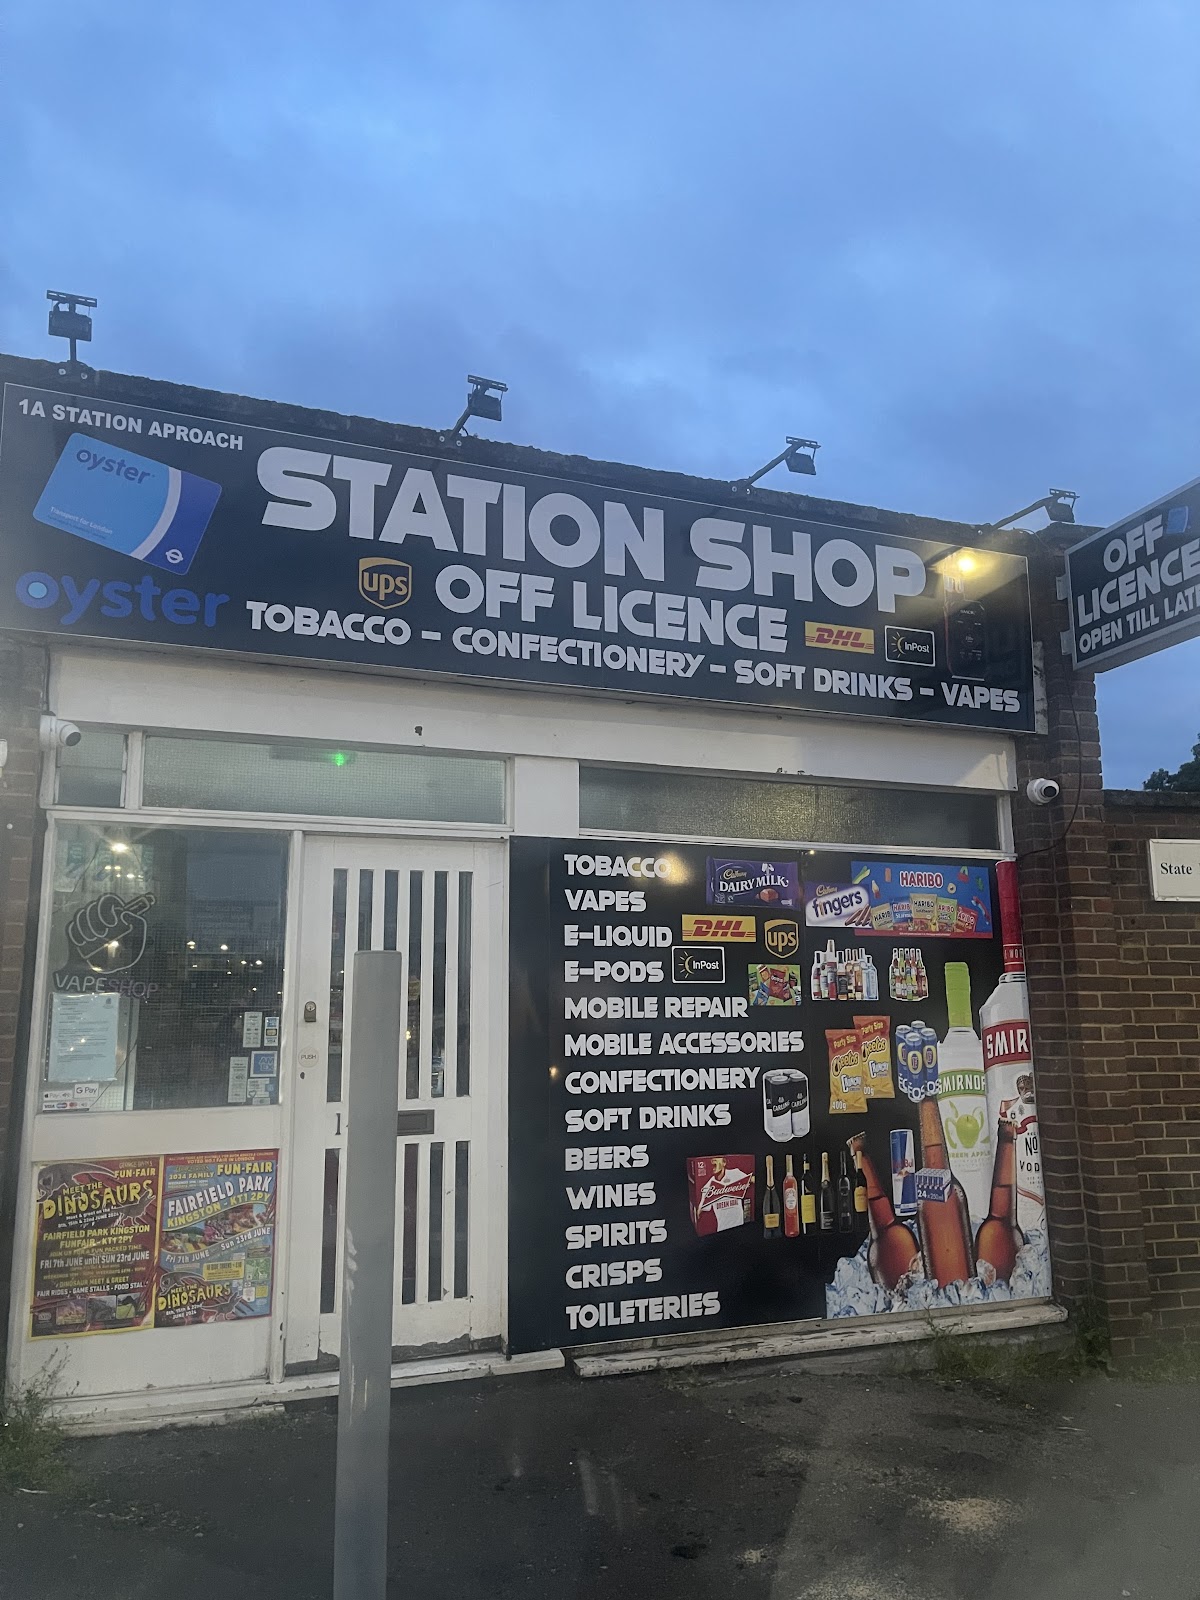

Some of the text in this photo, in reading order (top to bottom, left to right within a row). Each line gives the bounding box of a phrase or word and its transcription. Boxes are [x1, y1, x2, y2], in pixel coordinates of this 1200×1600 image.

[19, 399, 243, 450] 1A STATION APROACH
[76, 449, 150, 484] oyster
[50, 507, 79, 522] Transport
[90, 522, 112, 534] London
[256, 446, 926, 614] STATION SHOP
[1103, 514, 1164, 573] OFF
[363, 570, 408, 604] ups
[1077, 538, 1200, 628] LICENCE
[16, 571, 229, 626] oyster
[435, 565, 788, 653] OFF LICENCE
[815, 627, 865, 648] DHL
[1079, 618, 1123, 654] OPEN
[1126, 604, 1160, 635] TILL
[246, 600, 412, 645] TOBACCO
[452, 626, 705, 678] CONFECTIONERY
[734, 660, 805, 690] SOFT
[814, 668, 913, 701] DRINKS
[941, 682, 1021, 713] VAPES
[904, 641, 930, 654] InPost
[564, 853, 671, 878] TOBACCO
[1160, 862, 1192, 875] State
[719, 875, 789, 893] DAIRY MILK
[900, 871, 943, 888] HARIBO
[564, 889, 647, 912] VAPES
[812, 890, 863, 918] fingers
[914, 900, 934, 908] HARIBO
[564, 925, 673, 948] E-LIQUID
[692, 920, 746, 937] DHL
[767, 931, 797, 952] ups
[564, 960, 665, 983] E-PODS
[692, 961, 720, 970] InPost
[55, 972, 158, 999] VAPE SHOP
[564, 996, 749, 1020] MOBILE REPAIR
[564, 1031, 805, 1057] MOBILE ACCESSORIES
[831, 1050, 859, 1078] Cheetos
[84, 1087, 97, 1095] Pay
[564, 1066, 761, 1095] CONFECTIONERY
[564, 1103, 732, 1133] SOFT DRINKS
[564, 1144, 650, 1172] BEERS
[63, 1182, 103, 1195] MEET THE
[168, 1176, 272, 1217] FAIRFIELD PARK
[565, 1181, 657, 1211] WINES
[701, 1183, 750, 1198] Budweiser
[917, 1190, 927, 1198] 24
[167, 1192, 271, 1228] KINGSTON KT1 2PY
[43, 1225, 150, 1241] FAIRFIELD PARK KINGSTON
[60, 1238, 95, 1249] FUNFAIR
[118, 1235, 134, 1244] 2PY
[165, 1255, 176, 1263] Fri
[191, 1249, 210, 1262] JUNE
[220, 1242, 235, 1251] Sun
[236, 1233, 252, 1244] 23rd
[253, 1227, 271, 1238] JUNE
[565, 1219, 668, 1250] SPIRITS
[40, 1259, 52, 1269] FRI
[53, 1258, 65, 1268] 7th
[65, 1257, 83, 1267] JUNE
[84, 1256, 100, 1265] until
[101, 1254, 115, 1264] SUN
[116, 1252, 131, 1262] 23rd
[132, 1250, 150, 1261] JUNE
[565, 1258, 663, 1290] CRISPS
[37, 1289, 50, 1297] FAIR
[51, 1288, 68, 1296] RIDES
[89, 1284, 110, 1293] STALLS
[114, 1283, 129, 1291] FOOD
[565, 1291, 721, 1331] TOILETERIES
